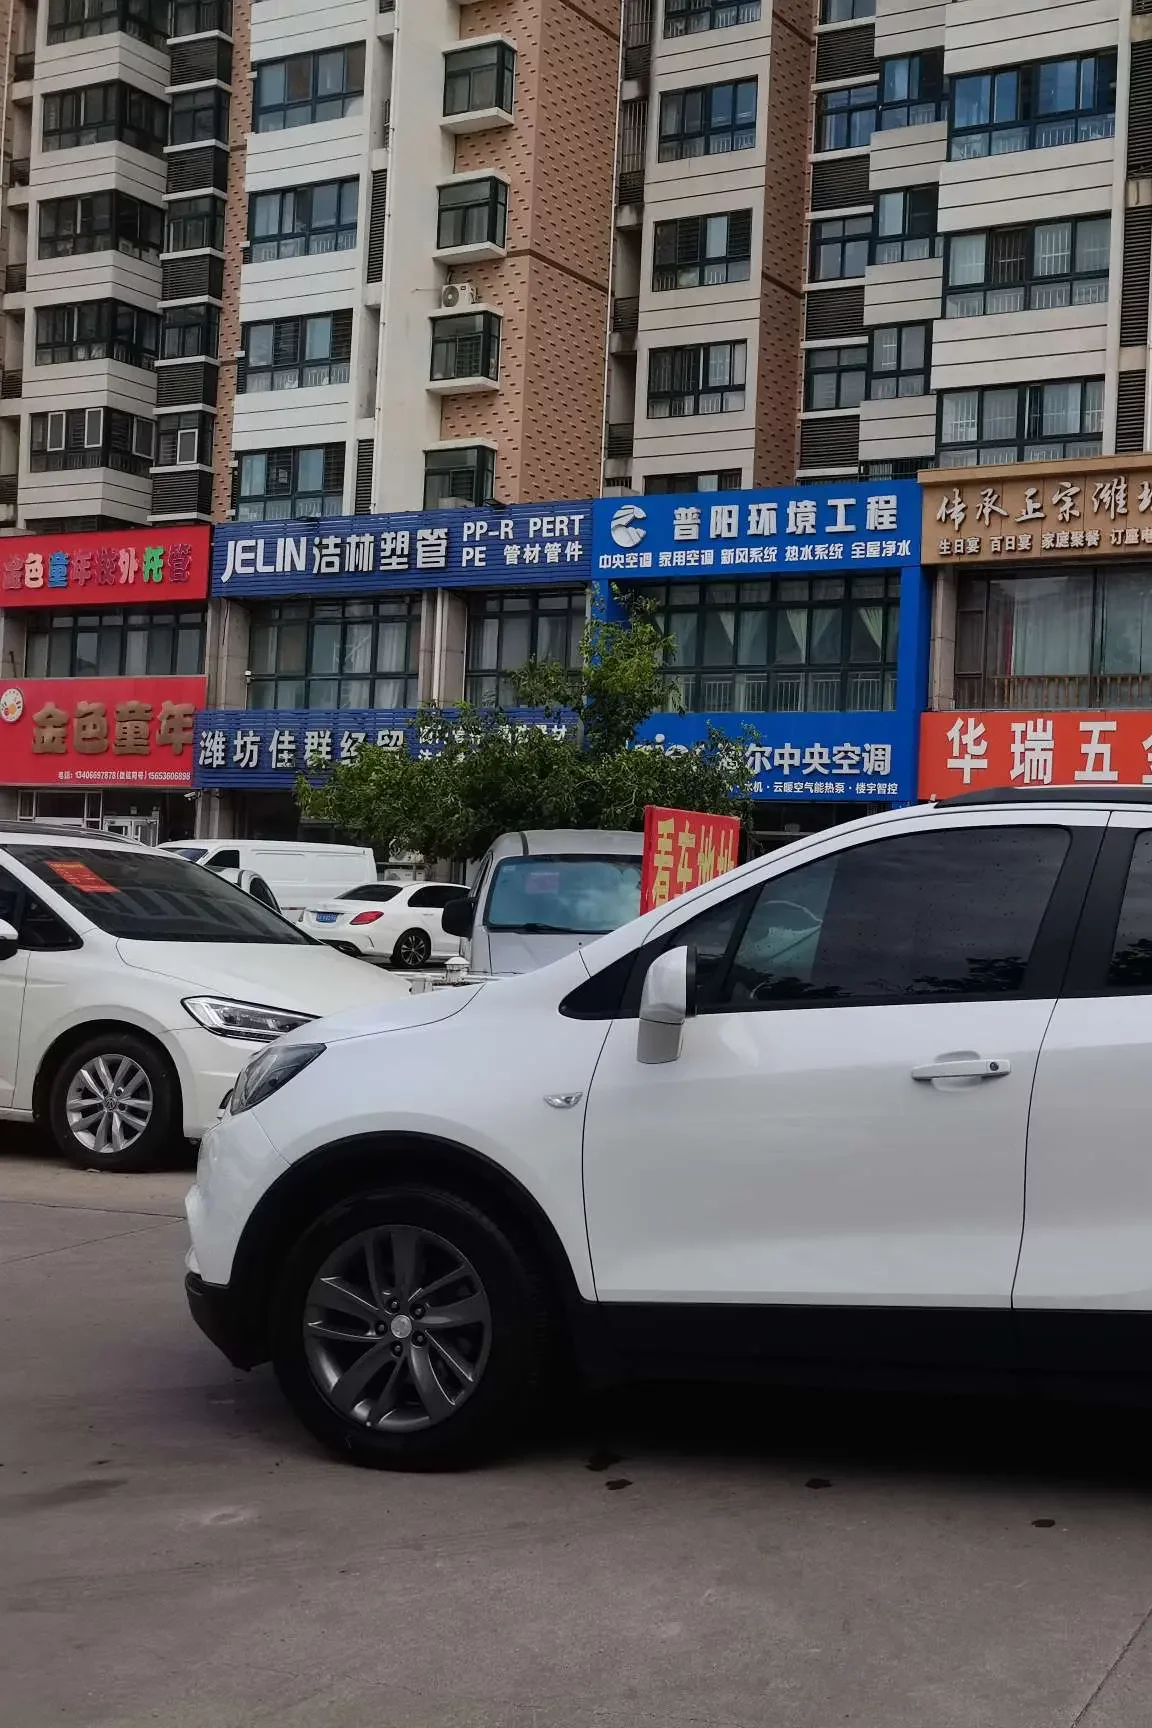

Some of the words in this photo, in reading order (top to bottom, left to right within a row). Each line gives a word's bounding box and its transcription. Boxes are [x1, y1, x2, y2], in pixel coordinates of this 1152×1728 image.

[463, 520, 514, 542] PP-R
[529, 514, 584, 538] PERT
[673, 495, 898, 541] 普阳环境工程
[221, 536, 307, 583] JELIN
[312, 528, 448, 574] 洁林塑管
[461, 546, 487, 567] PE
[503, 540, 583, 566] 管材管件
[599, 552, 652, 569] 中央空调
[658, 549, 714, 567] 家用空调
[720, 546, 777, 565] 新风系统
[785, 542, 844, 562] 热水系统
[851, 539, 912, 559] 全屋净水
[938, 537, 980, 556] 生日宴
[989, 534, 1033, 553] 百日宴
[1041, 530, 1101, 550] 家庭聚餐
[32, 700, 194, 756] 金色童年
